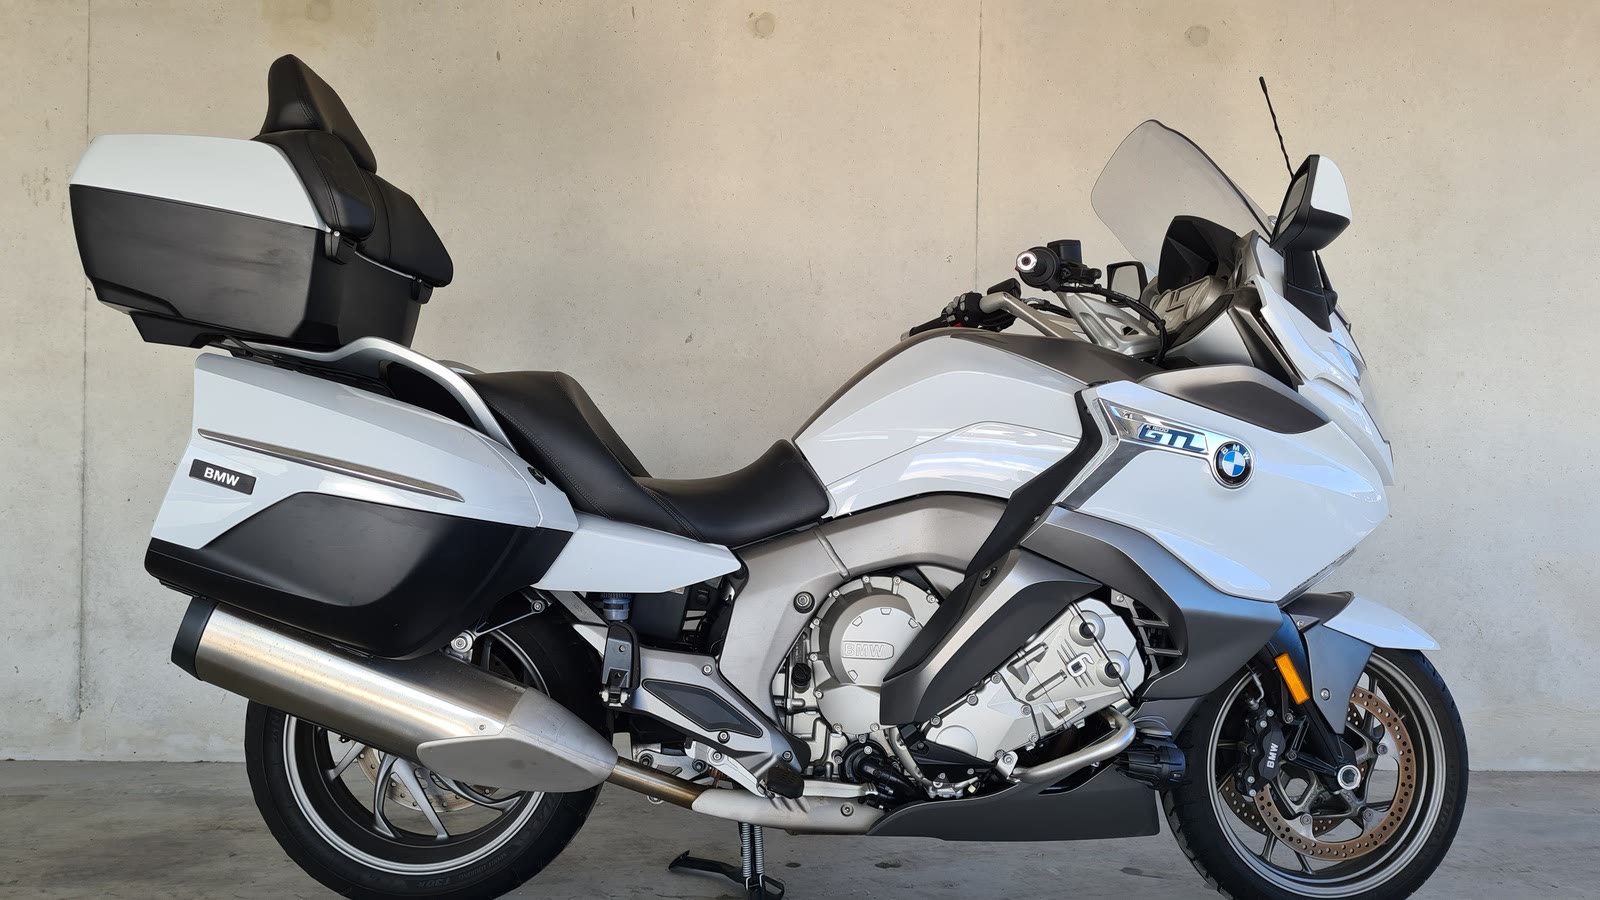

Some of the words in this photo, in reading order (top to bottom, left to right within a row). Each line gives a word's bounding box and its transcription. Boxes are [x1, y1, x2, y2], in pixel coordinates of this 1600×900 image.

[1138, 423, 1205, 452] GTL
[204, 467, 240, 487] BMW
[844, 643, 885, 658] BMW
[1266, 743, 1279, 769] BMW
